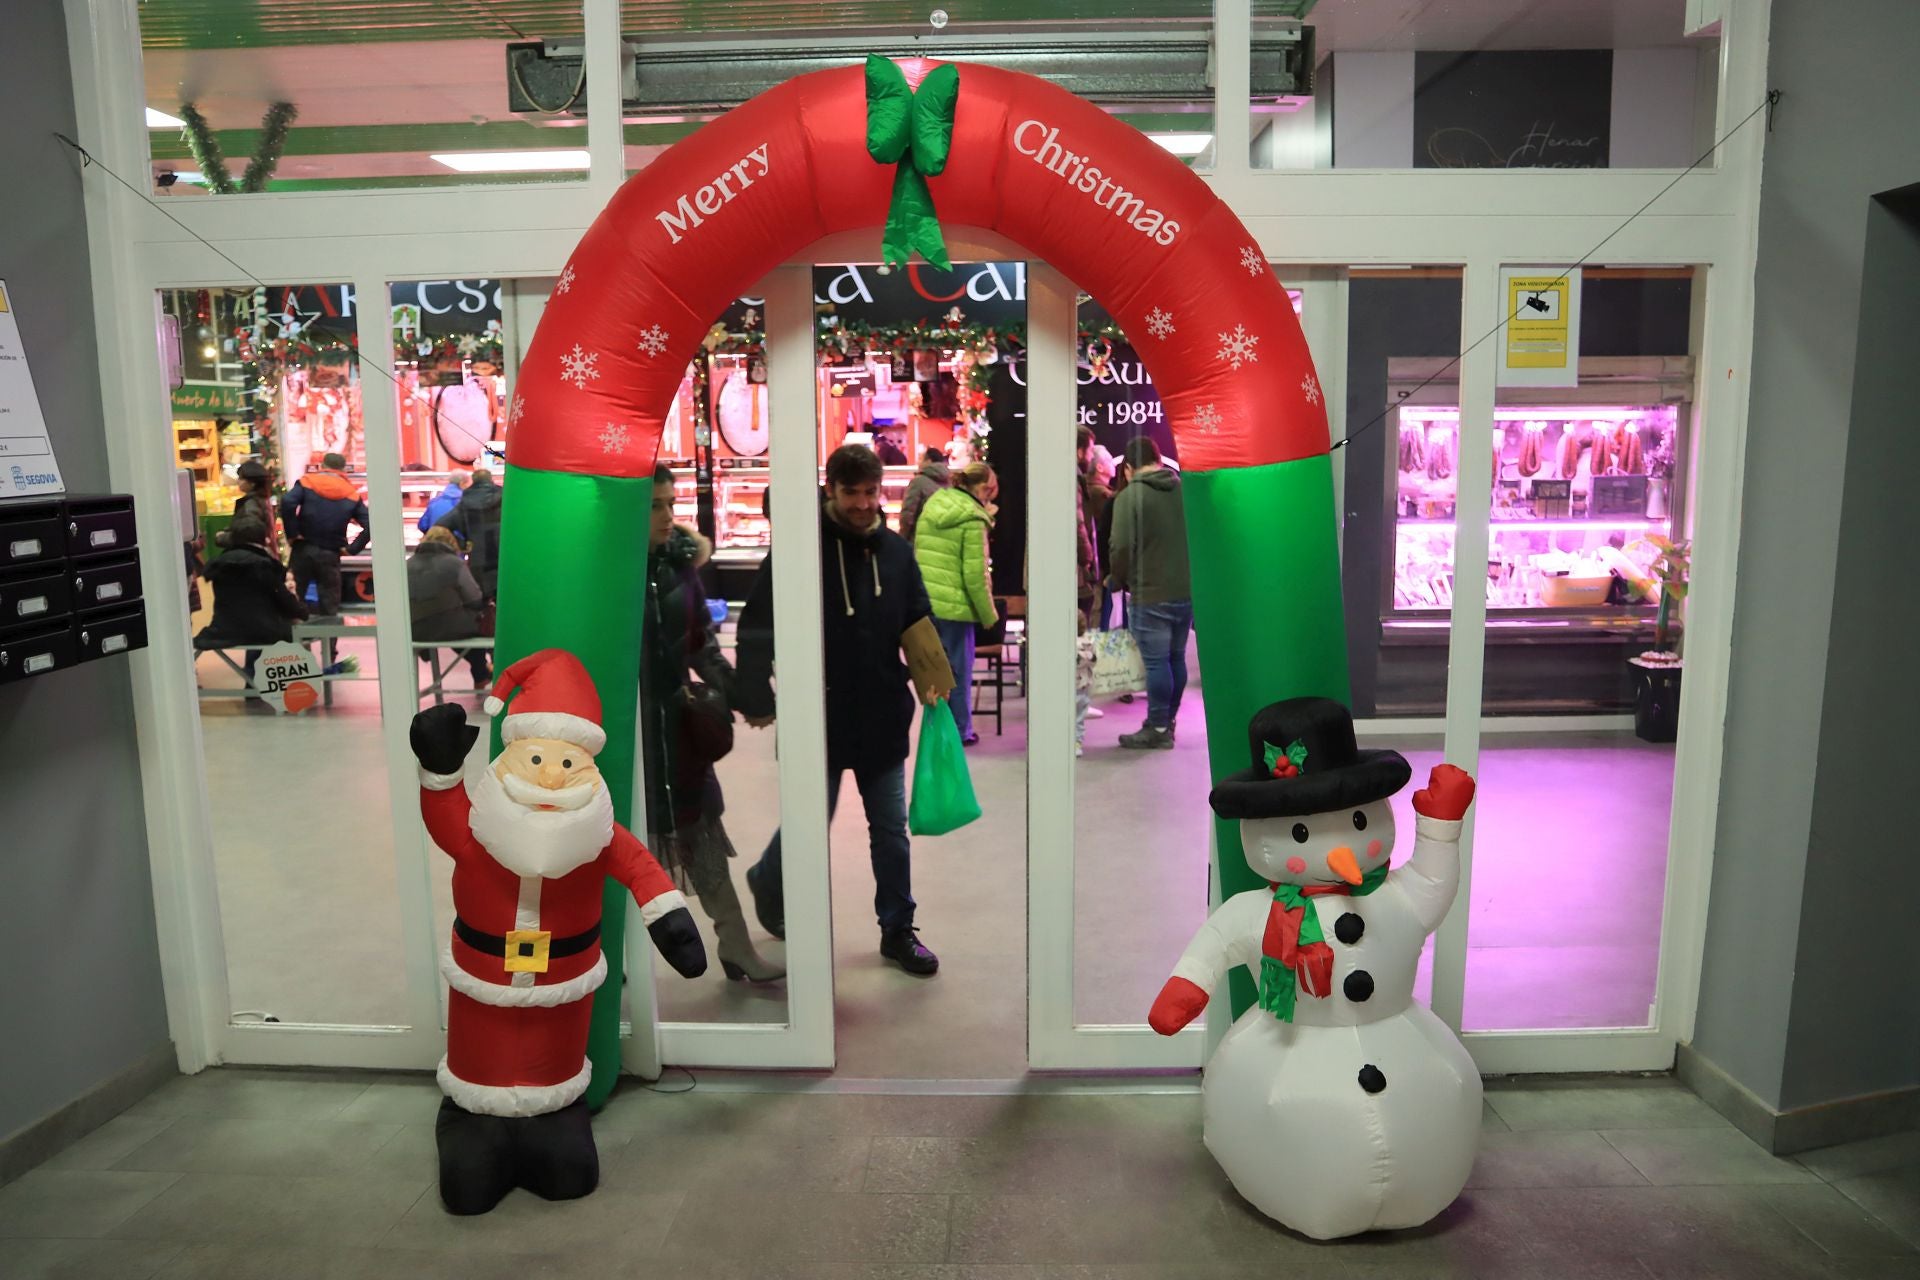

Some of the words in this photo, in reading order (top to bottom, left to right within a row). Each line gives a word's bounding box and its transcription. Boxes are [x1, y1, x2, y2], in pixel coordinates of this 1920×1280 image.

[1522, 120, 1598, 157] Henar
[655, 142, 771, 245] Merry
[1013, 119, 1181, 246] Christmas
[1107, 401, 1163, 425] 1984
[25, 473, 58, 486] SEGOVIA
[263, 655, 300, 666] COMPRA
[265, 663, 309, 679] GRAN
[267, 680, 288, 693] DE
